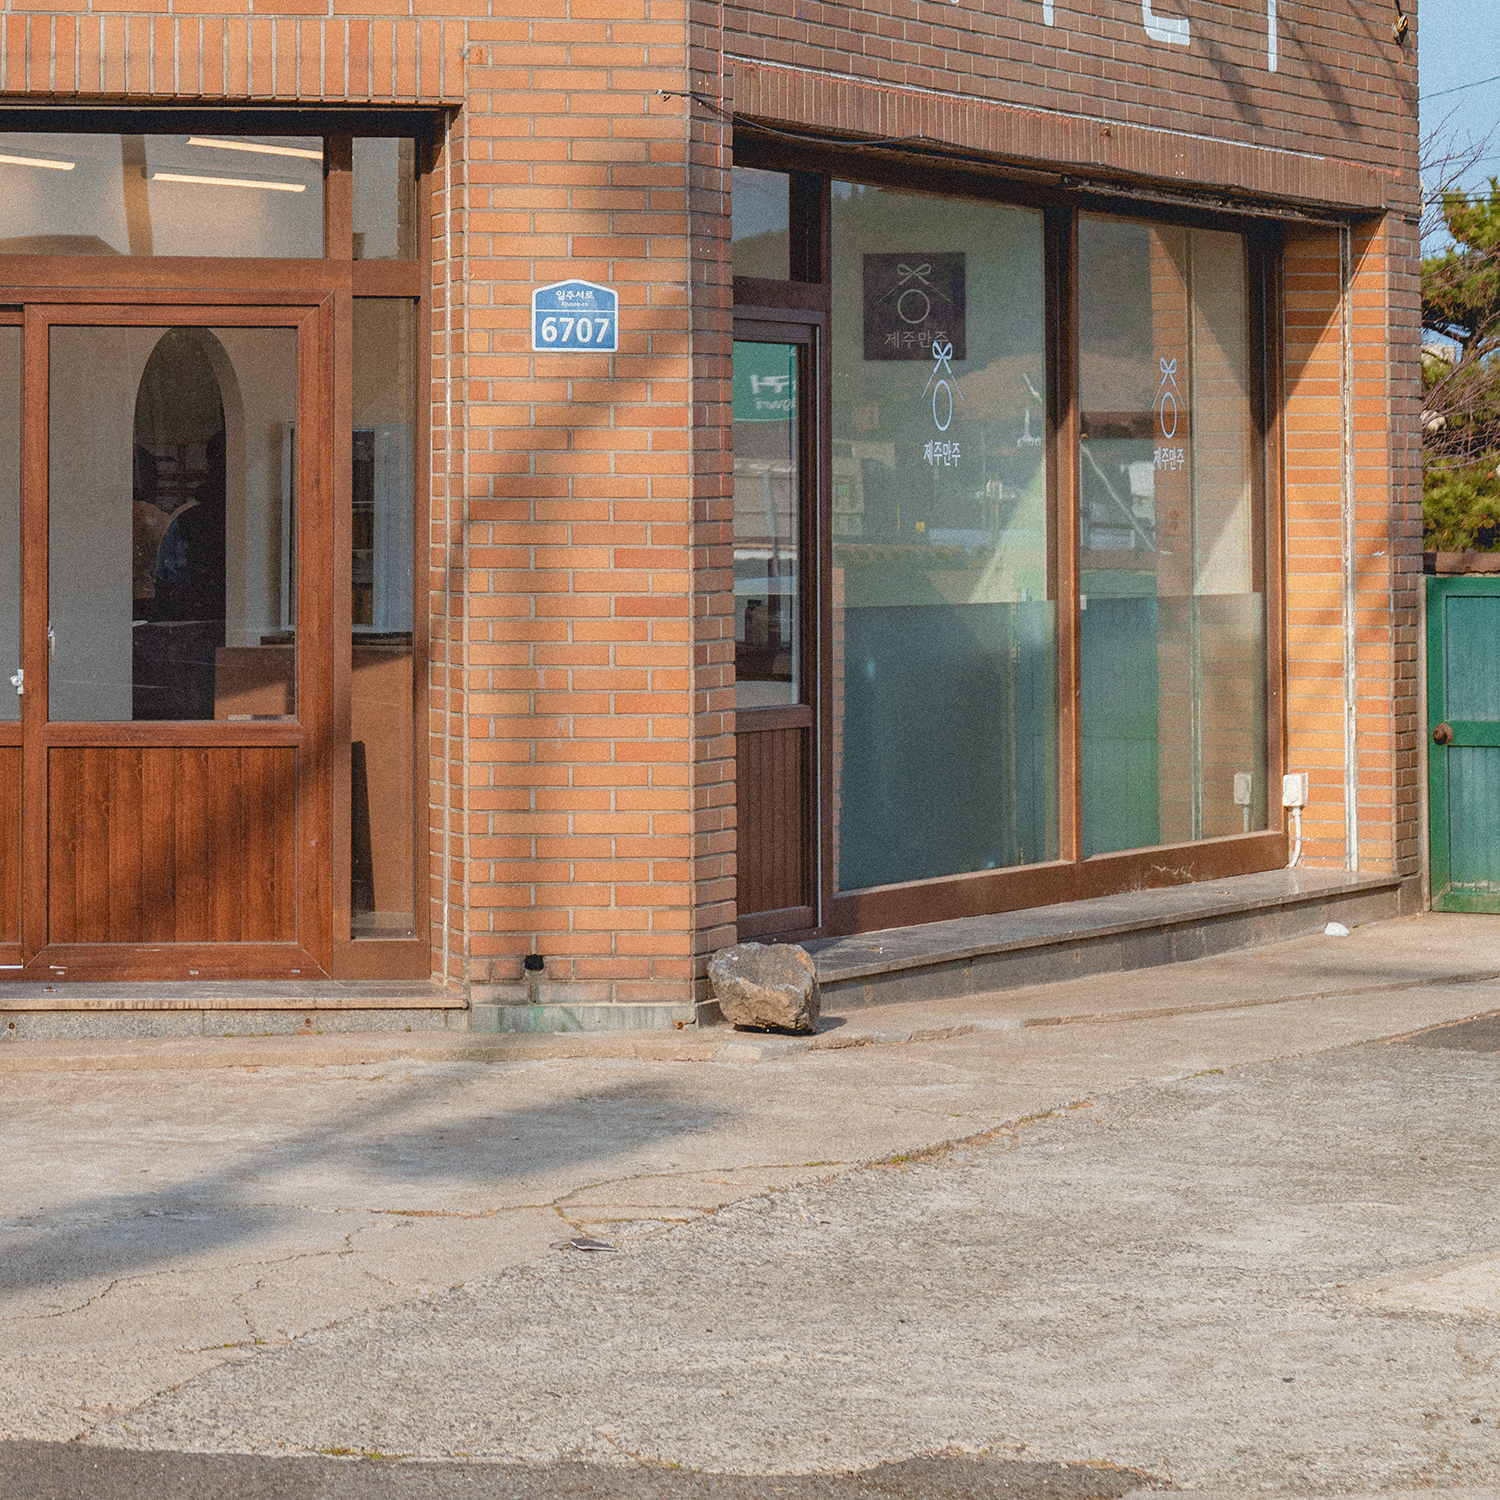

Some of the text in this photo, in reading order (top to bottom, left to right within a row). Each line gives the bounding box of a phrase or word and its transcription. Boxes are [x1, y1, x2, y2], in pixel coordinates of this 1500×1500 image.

[555, 290, 595, 301] 일주서로
[541, 317, 610, 343] 6707
[884, 330, 949, 349] 제주만주
[923, 440, 961, 467] 제주만주
[1153, 446, 1185, 471] 제주만주
